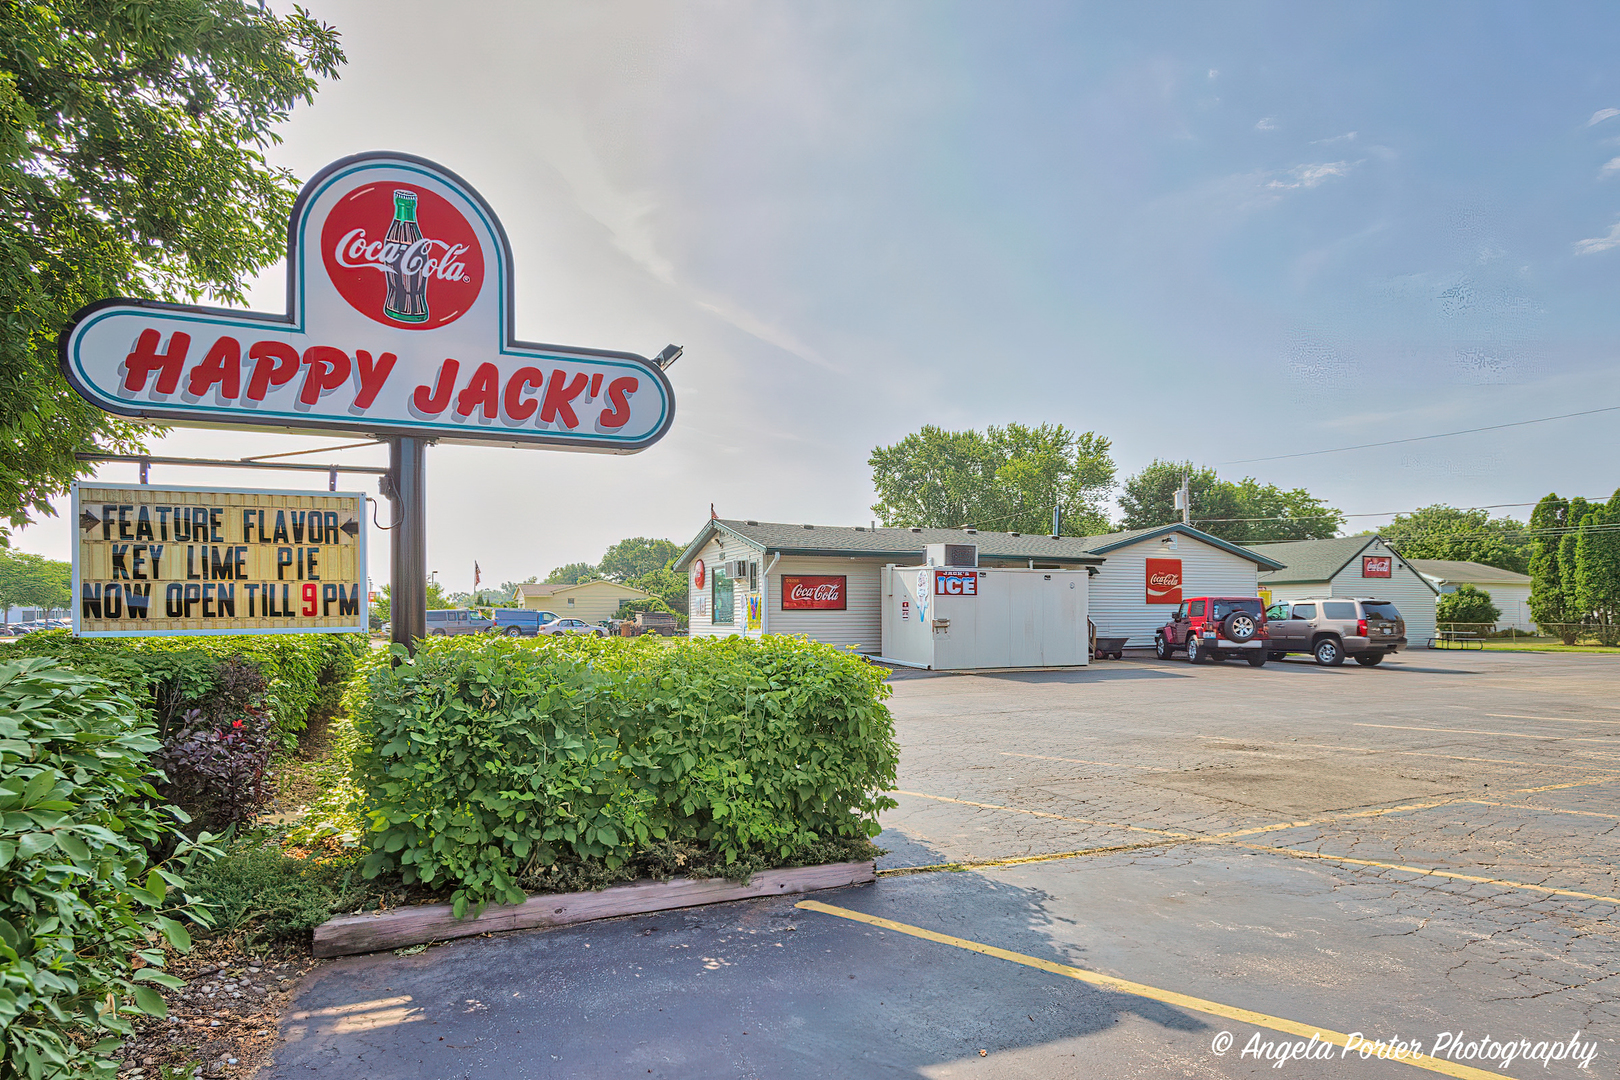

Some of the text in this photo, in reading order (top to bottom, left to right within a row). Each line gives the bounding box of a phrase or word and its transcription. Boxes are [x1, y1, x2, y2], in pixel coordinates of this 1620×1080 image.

[334, 228, 470, 282] Coca-Cola
[124, 327, 639, 431] HAPPY JACK'S
[102, 504, 339, 545] FEATURE FLAVOR
[112, 544, 320, 580] KEY LIME PIE
[83, 583, 151, 619] NOW
[166, 583, 235, 618] OPEN
[244, 583, 296, 617] TILL
[791, 583, 840, 601] Coca-Cola
[937, 576, 975, 594] ICE
